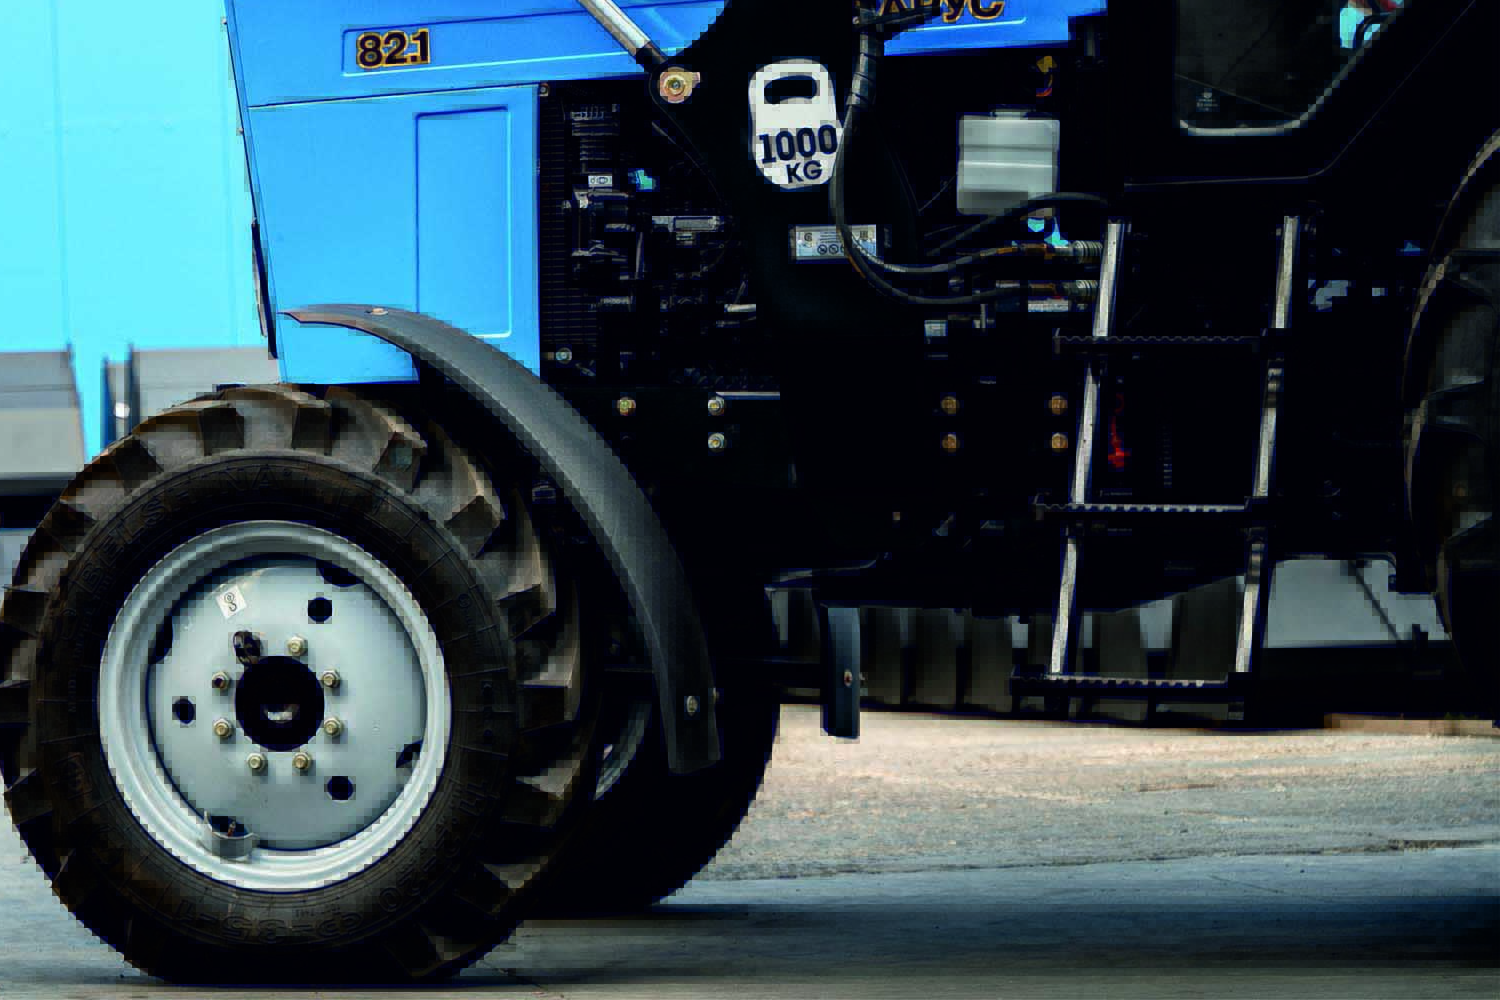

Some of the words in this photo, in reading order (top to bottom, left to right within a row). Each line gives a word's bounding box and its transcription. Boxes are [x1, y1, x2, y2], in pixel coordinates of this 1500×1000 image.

[355, 28, 431, 69] 82.1
[758, 124, 838, 164] 1000
[786, 160, 823, 183] KG
